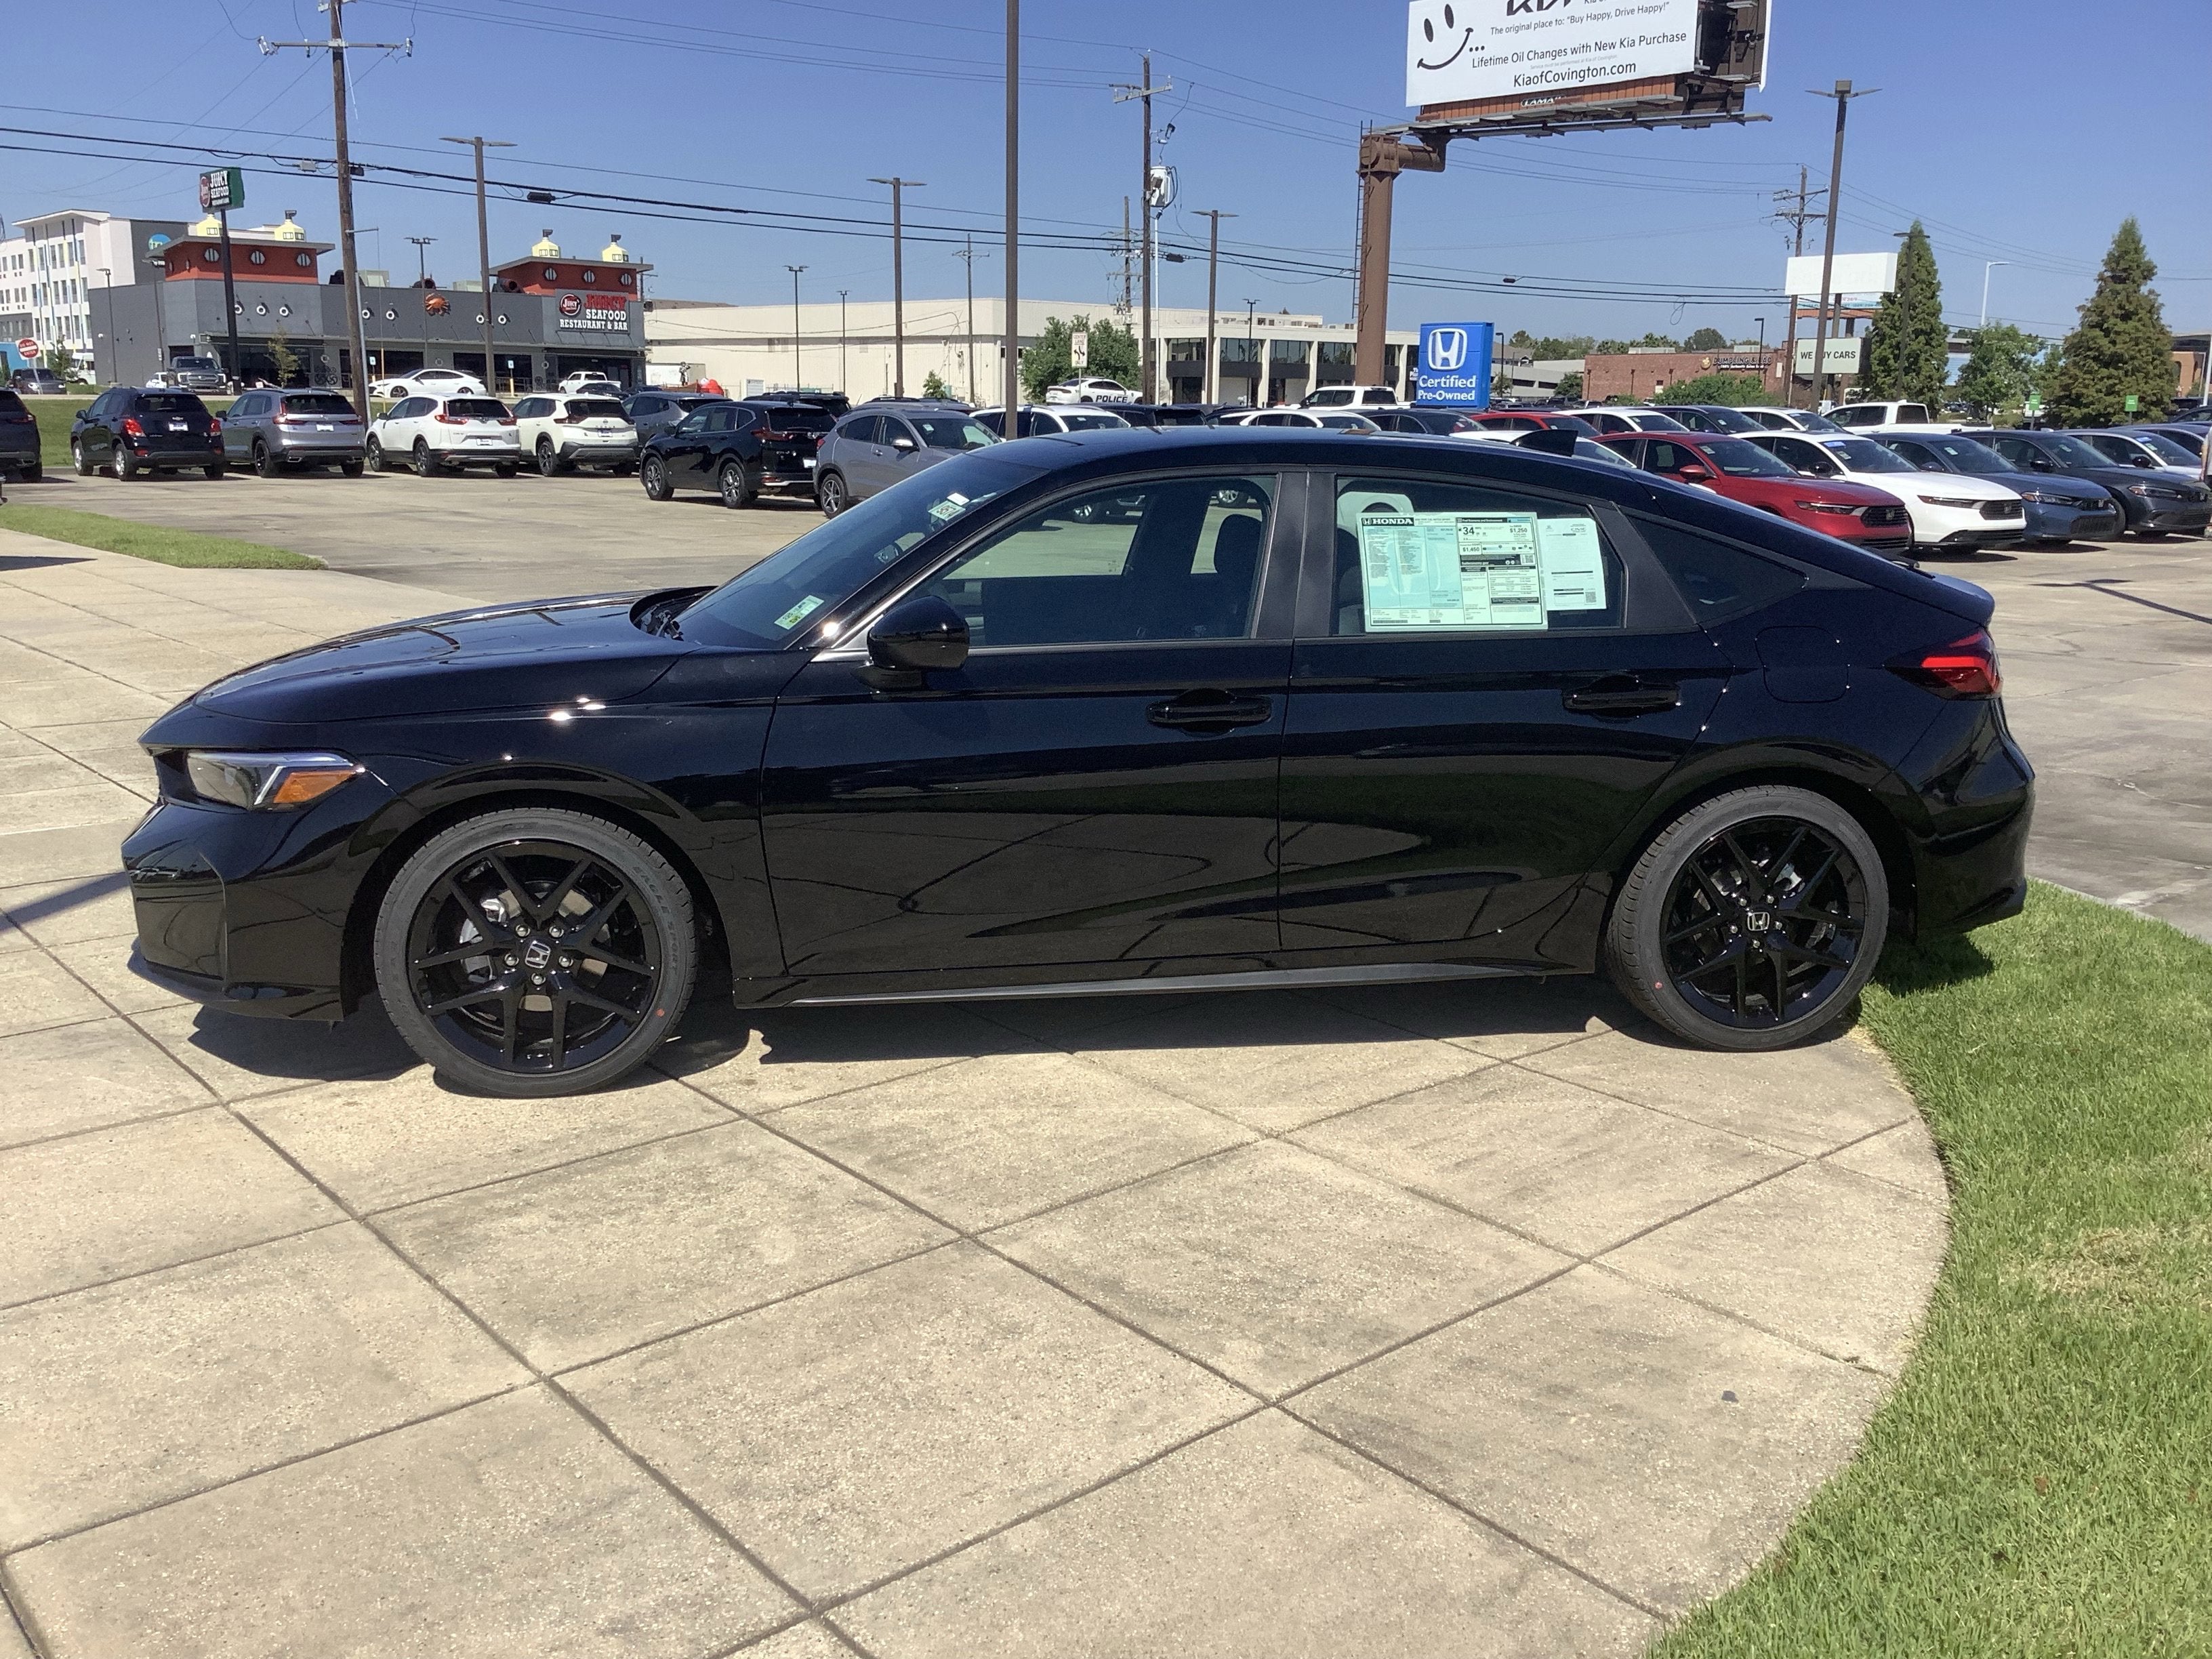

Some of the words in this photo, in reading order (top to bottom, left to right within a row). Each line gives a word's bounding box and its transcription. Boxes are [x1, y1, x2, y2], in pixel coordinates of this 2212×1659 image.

[1491, 27, 1503, 35] The
[1505, 21, 1532, 34] original
[1534, 18, 1553, 30] place
[1555, 17, 1565, 26] to:
[1586, 10, 1613, 22] Happy,
[1615, 7, 1635, 18] Drive
[1472, 55, 1509, 68] Lifetime
[1511, 52, 1524, 63] Oil
[1527, 47, 1568, 60] Changes
[1570, 43, 1591, 55] with
[1595, 41, 1617, 52] New
[1620, 37, 1635, 48] Kia
[1639, 33, 1687, 46] Purchase
[1513, 62, 1637, 87] KiaofCovington.com
[210, 170, 228, 188] JUICY
[211, 186, 229, 199] SEAFOOD
[584, 293, 627, 310] JUICY
[586, 308, 626, 321] SEAFOOD
[560, 319, 606, 329] RESTAURANT
[607, 321, 612, 329] &
[614, 321, 628, 331] BAR
[1801, 351, 1813, 359] WE
[1822, 351, 1832, 359] UY
[1833, 350, 1856, 359] CARS
[1418, 375, 1477, 388] Certified
[1418, 390, 1475, 401] Pre-Owned
[1462, 527, 1475, 535] 34
